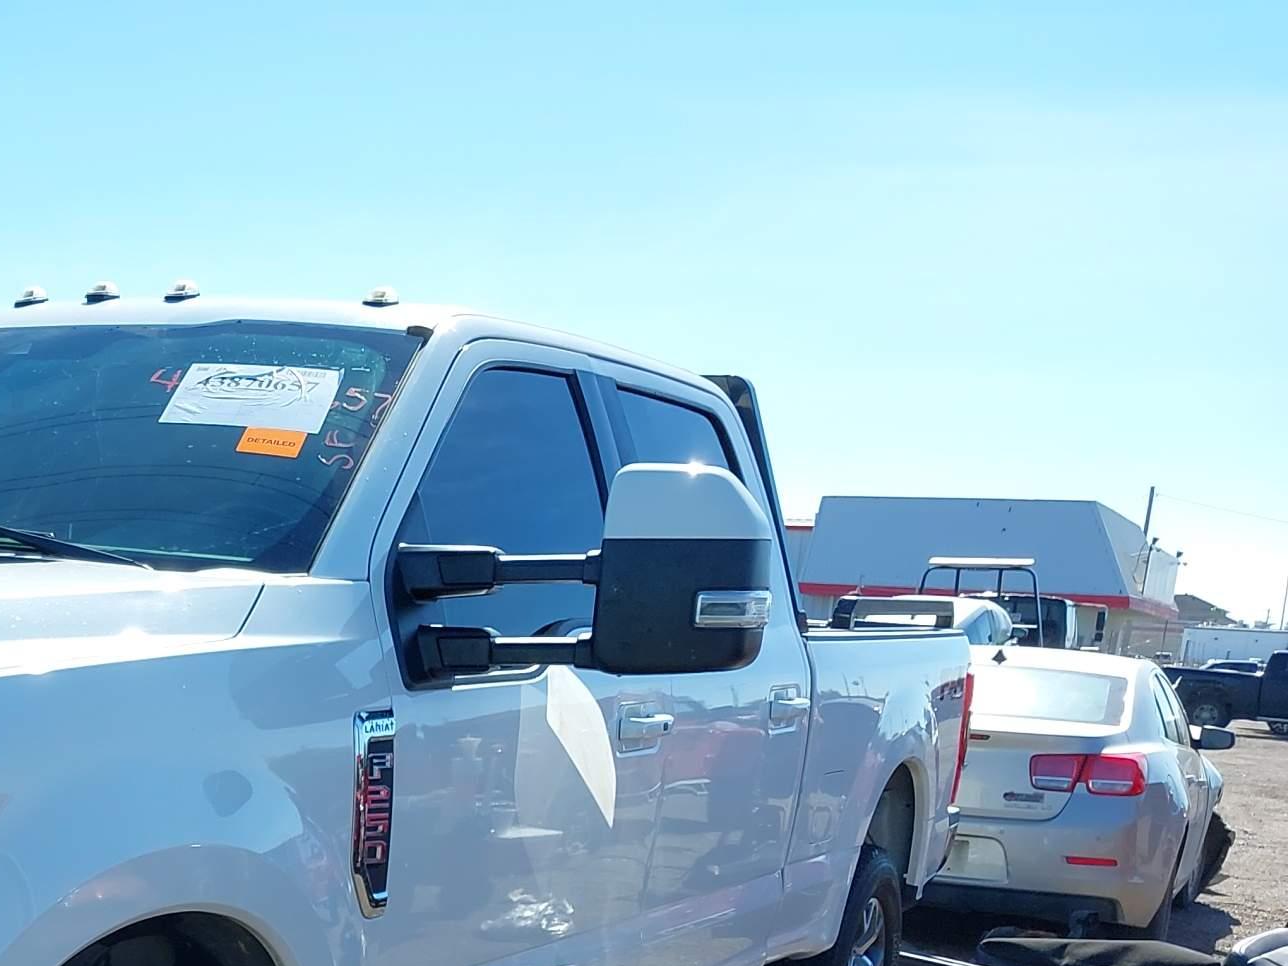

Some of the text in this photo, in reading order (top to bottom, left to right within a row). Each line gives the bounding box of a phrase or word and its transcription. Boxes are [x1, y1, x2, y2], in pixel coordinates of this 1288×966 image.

[246, 436, 296, 448] DETAILED
[364, 720, 394, 734] LARIAT
[364, 752, 394, 865] F250
